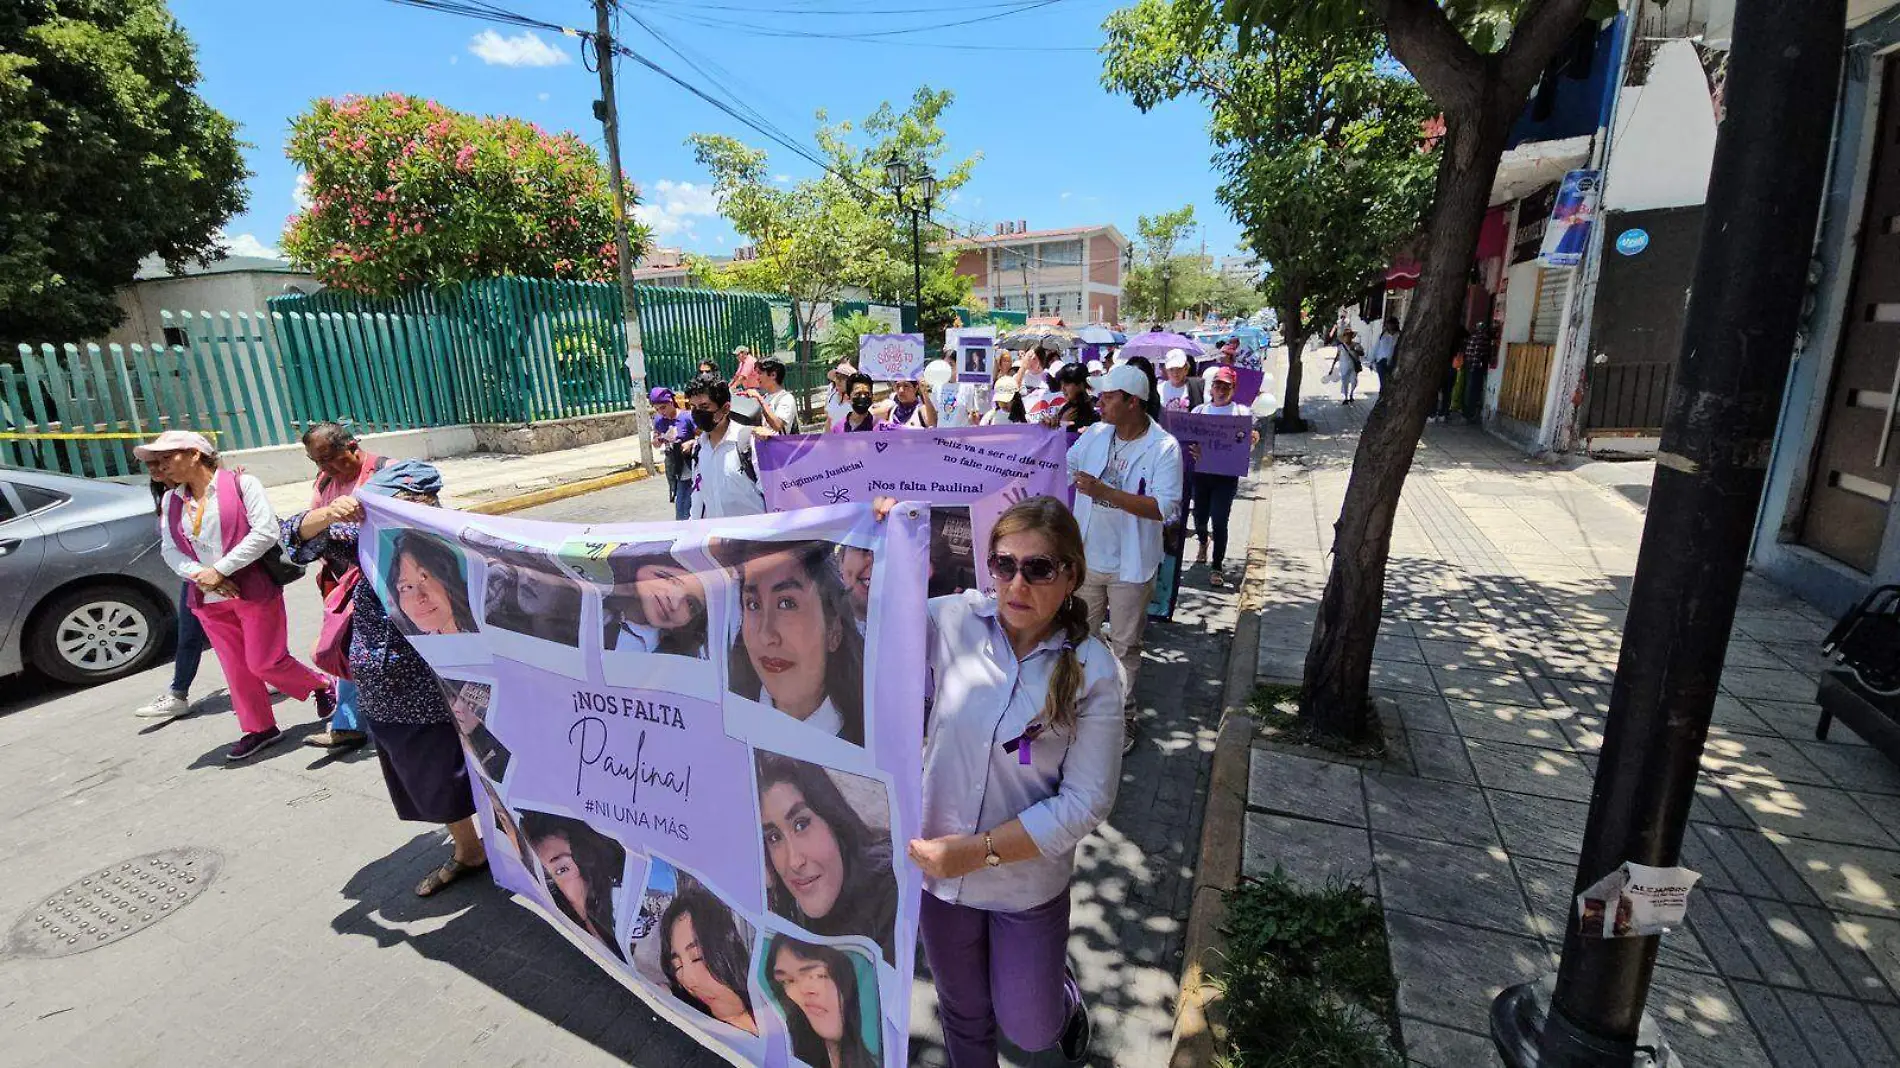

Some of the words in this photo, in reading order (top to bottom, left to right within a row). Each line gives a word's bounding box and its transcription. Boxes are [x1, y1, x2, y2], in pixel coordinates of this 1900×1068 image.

[825, 460, 864, 479] Justicia!
[943, 454, 957, 464] no
[960, 458, 983, 470] falte
[964, 444, 976, 453] va
[979, 447, 985, 456] a
[987, 450, 1006, 460] ser
[1006, 453, 1017, 462] el
[1018, 456, 1036, 466] día
[1038, 459, 1060, 471] que
[867, 480, 896, 492] ¡Nos
[898, 481, 927, 491] falta
[930, 481, 984, 493] Paulina!
[572, 691, 618, 715] ¡NOS
[621, 697, 686, 730] FALTA
[568, 716, 691, 804] Paulina!
[585, 799, 610, 818] #NI
[613, 804, 651, 829] UNA
[653, 815, 690, 841] MÁS
